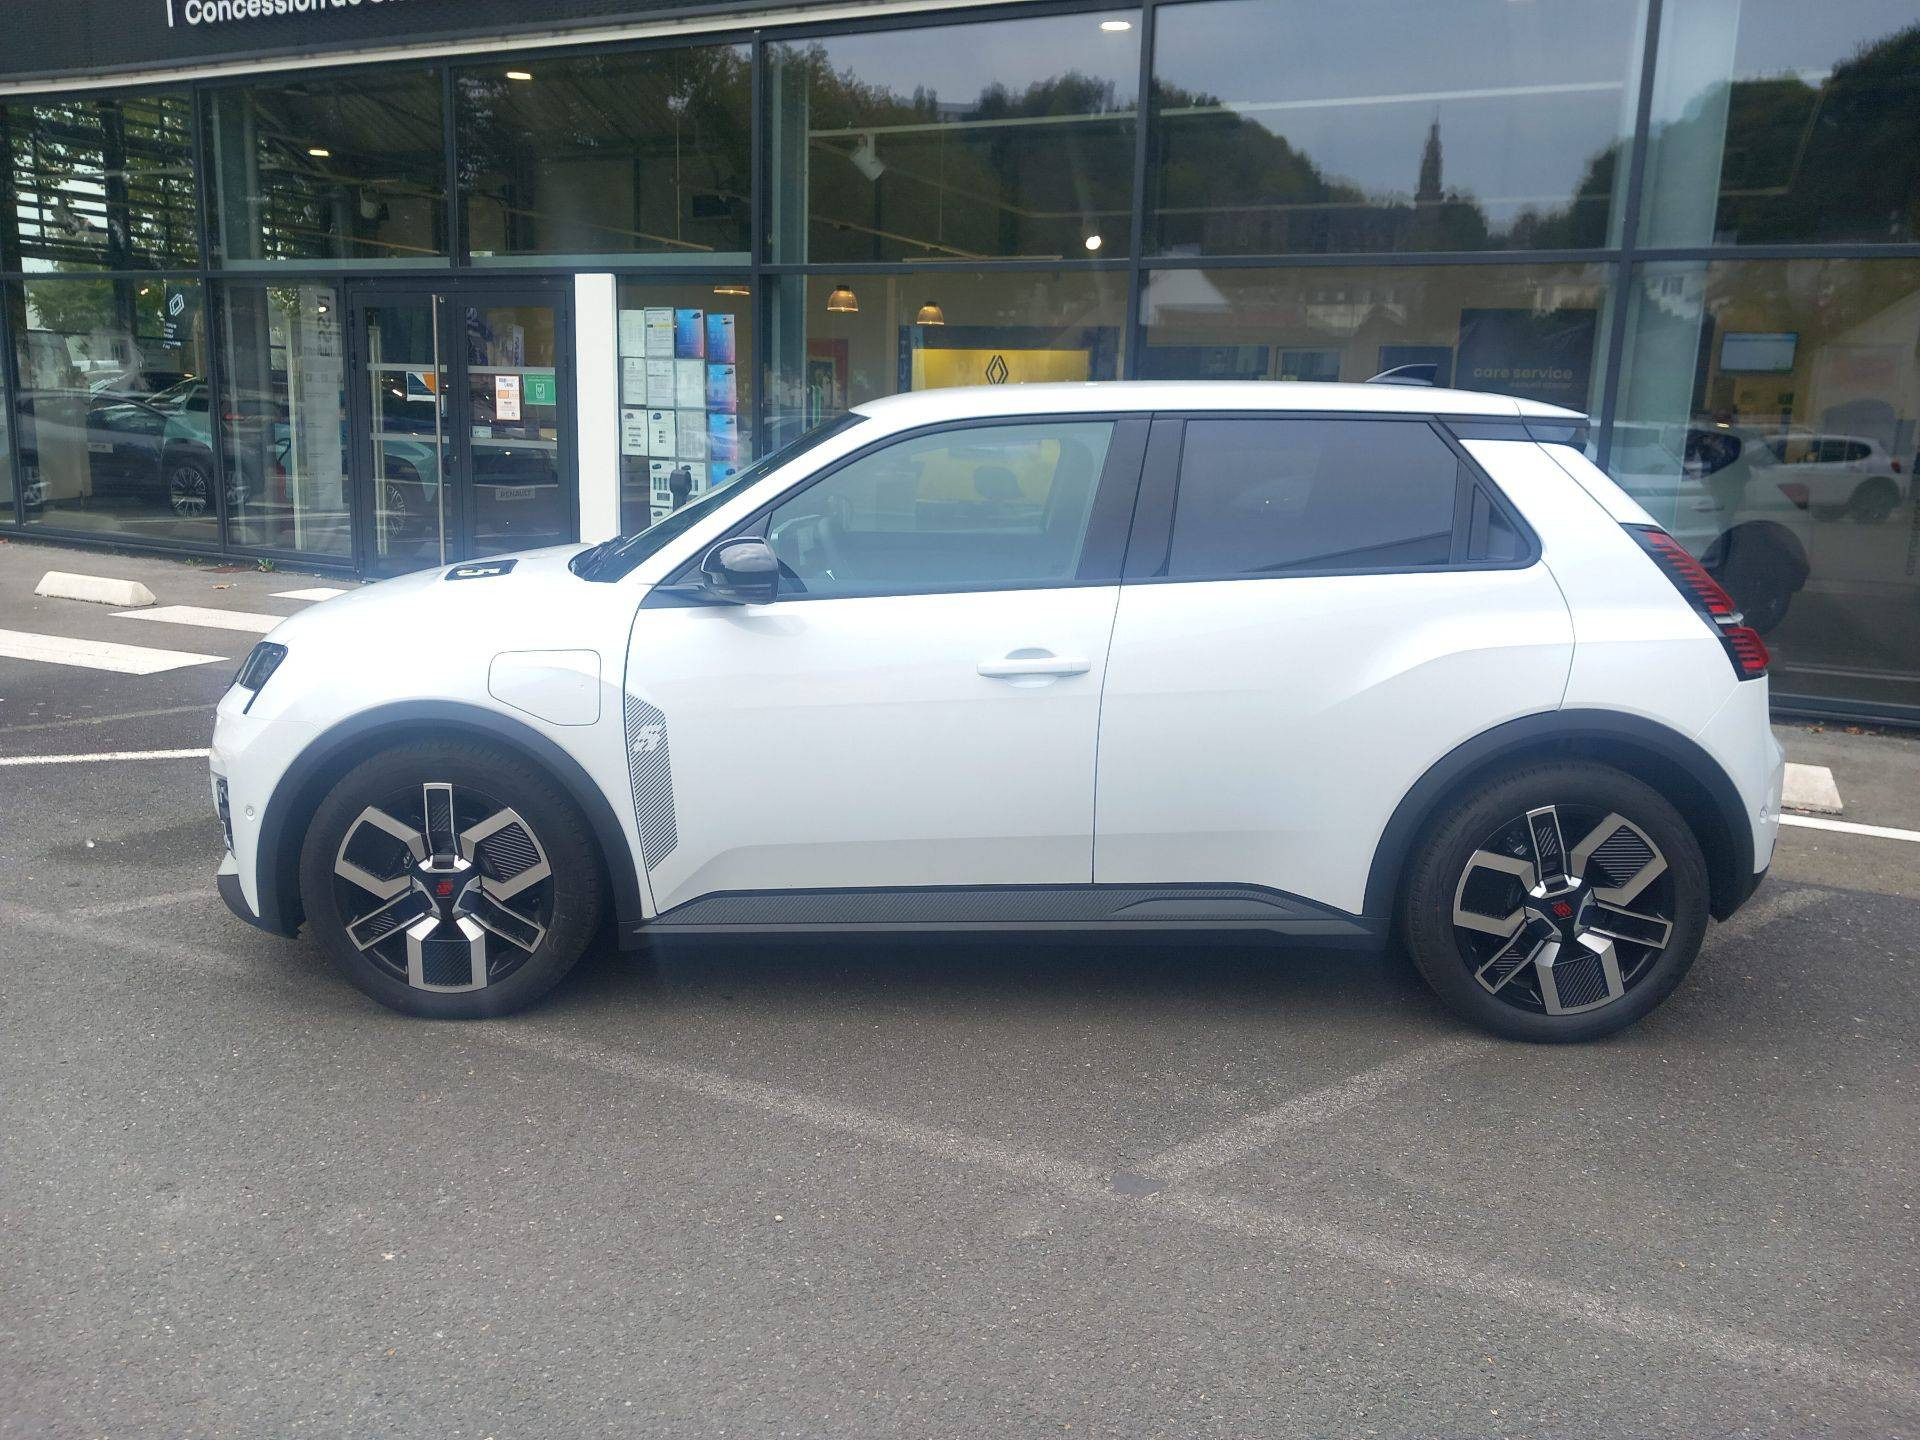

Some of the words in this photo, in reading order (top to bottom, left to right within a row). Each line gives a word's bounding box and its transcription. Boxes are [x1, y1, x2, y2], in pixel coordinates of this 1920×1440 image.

[185, 0, 326, 25] Concession
[1473, 368, 1510, 379] care
[1512, 366, 1574, 380] service
